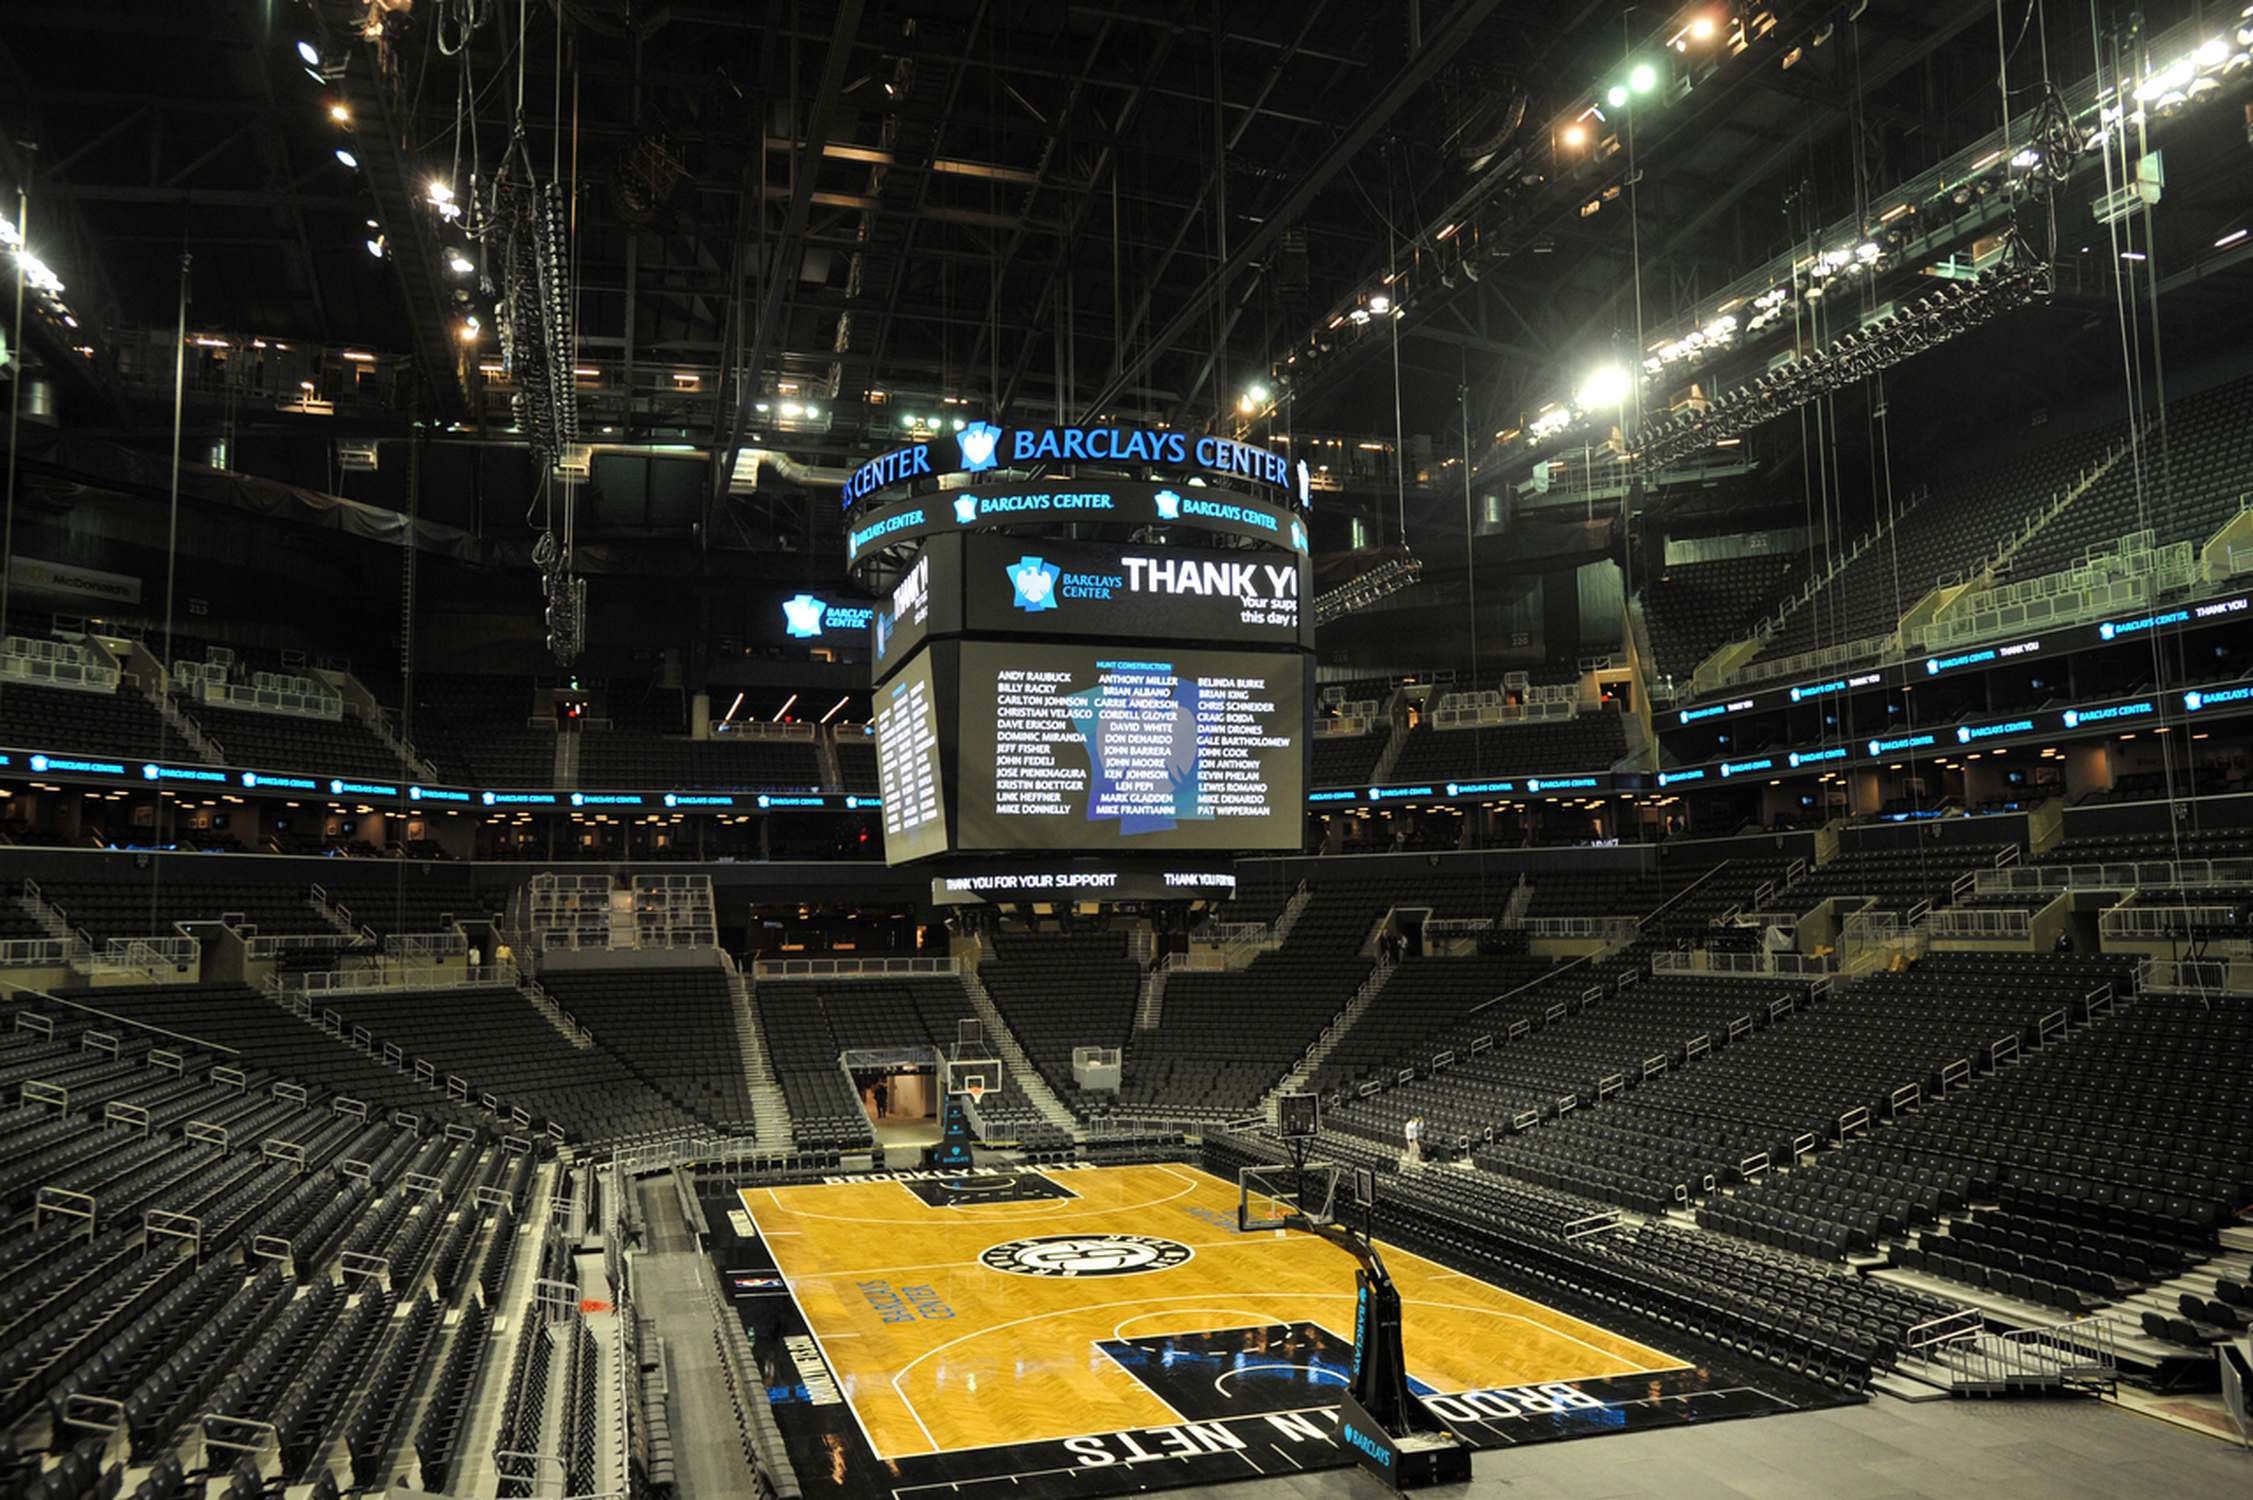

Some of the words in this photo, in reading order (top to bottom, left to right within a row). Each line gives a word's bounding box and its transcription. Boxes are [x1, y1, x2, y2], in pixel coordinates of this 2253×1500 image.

[1013, 430, 1187, 462] BARCLAYS
[1195, 437, 1289, 487] CENTER
[854, 445, 930, 497] CENTER
[981, 495, 1050, 513] BARCLAYS
[1054, 494, 1113, 509] CENTER
[886, 510, 925, 531] CENTER
[1182, 500, 1241, 519] BARCLAYS
[1242, 508, 1278, 531] CENTER
[1063, 573, 1122, 588] BARCLAYS
[1121, 557, 1257, 597] THANK
[1063, 587, 1112, 599] CENTER
[1240, 595, 1269, 608] Your
[2196, 602, 2226, 616] THANK
[2227, 599, 2248, 611] YOU
[825, 618, 867, 628] CENTER
[1240, 610, 1265, 623] this
[1267, 611, 1290, 627] day
[998, 671, 1024, 680] ANDY
[1099, 674, 1144, 684] ANTHONY
[1145, 676, 1178, 686] MILLER
[998, 683, 1022, 692] BILLY
[1198, 677, 1235, 688] BELINDA
[1104, 686, 1131, 696] BRIAN
[1199, 689, 1226, 699] BRIAN
[1227, 690, 1249, 700] KING
[2202, 688, 2247, 704] BARCLAYS
[997, 695, 1042, 705] CARLTON
[1044, 696, 1088, 706] JOHNSON
[1095, 698, 1127, 707] CARRIE
[1129, 699, 1178, 709] ANDERSON
[1198, 701, 1224, 711] CHRIS
[1226, 702, 1275, 712] SCHNEIDER
[997, 707, 1048, 717] CHRISTIAN
[1050, 709, 1092, 719] VELASCO
[1142, 711, 1178, 721] GLOVER
[1197, 713, 1224, 722] CRAIG
[997, 719, 1024, 729] DAVE
[1025, 720, 1065, 730] ERICSON
[1110, 722, 1139, 731] DAVID
[1143, 723, 1172, 733] WHITE
[1198, 724, 1226, 734] DAWN
[997, 731, 1040, 741] DOMINIC
[1042, 733, 1087, 742] MIRANDA
[1105, 733, 1126, 743] DON
[1197, 736, 1220, 745] GALE
[1221, 736, 1290, 747] BARTHOLOMEW
[997, 743, 1016, 753] JEFF
[1018, 744, 1050, 753] FISHER
[1104, 745, 1129, 756] JOHN
[1198, 747, 1221, 758] JOHN
[1222, 748, 1248, 758] COOK
[997, 756, 1021, 766] JOHN
[1106, 757, 1129, 768] JOHN
[1131, 758, 1166, 768] MOORE
[1199, 759, 1215, 769] JON
[1216, 759, 1261, 769] ANTHONY
[997, 768, 1018, 778] JOSE
[1126, 769, 1169, 779] JOHNSON
[1198, 771, 1223, 780] KEVIN
[997, 780, 1033, 789] KRISTIN
[1199, 783, 1225, 793] LEWIS
[1226, 783, 1268, 793] ROMANO
[1100, 793, 1128, 803] MARK
[1198, 794, 1220, 804] MIKE
[996, 804, 1020, 813] MIKE
[1022, 804, 1070, 814] DONNELLY
[1096, 805, 1119, 814] MIKE
[1197, 806, 1215, 815] PAT
[972, 877, 993, 889] YOU
[995, 876, 1017, 888] FOR
[1018, 875, 1053, 887] YOUR
[1055, 874, 1117, 887] SUPPORT
[1164, 873, 1198, 886] THANK
[823, 1167, 998, 1185] BROOKLYN
[1063, 1422, 1247, 1466] NETS
[1352, 1428, 1390, 1466] BARCLAYS
